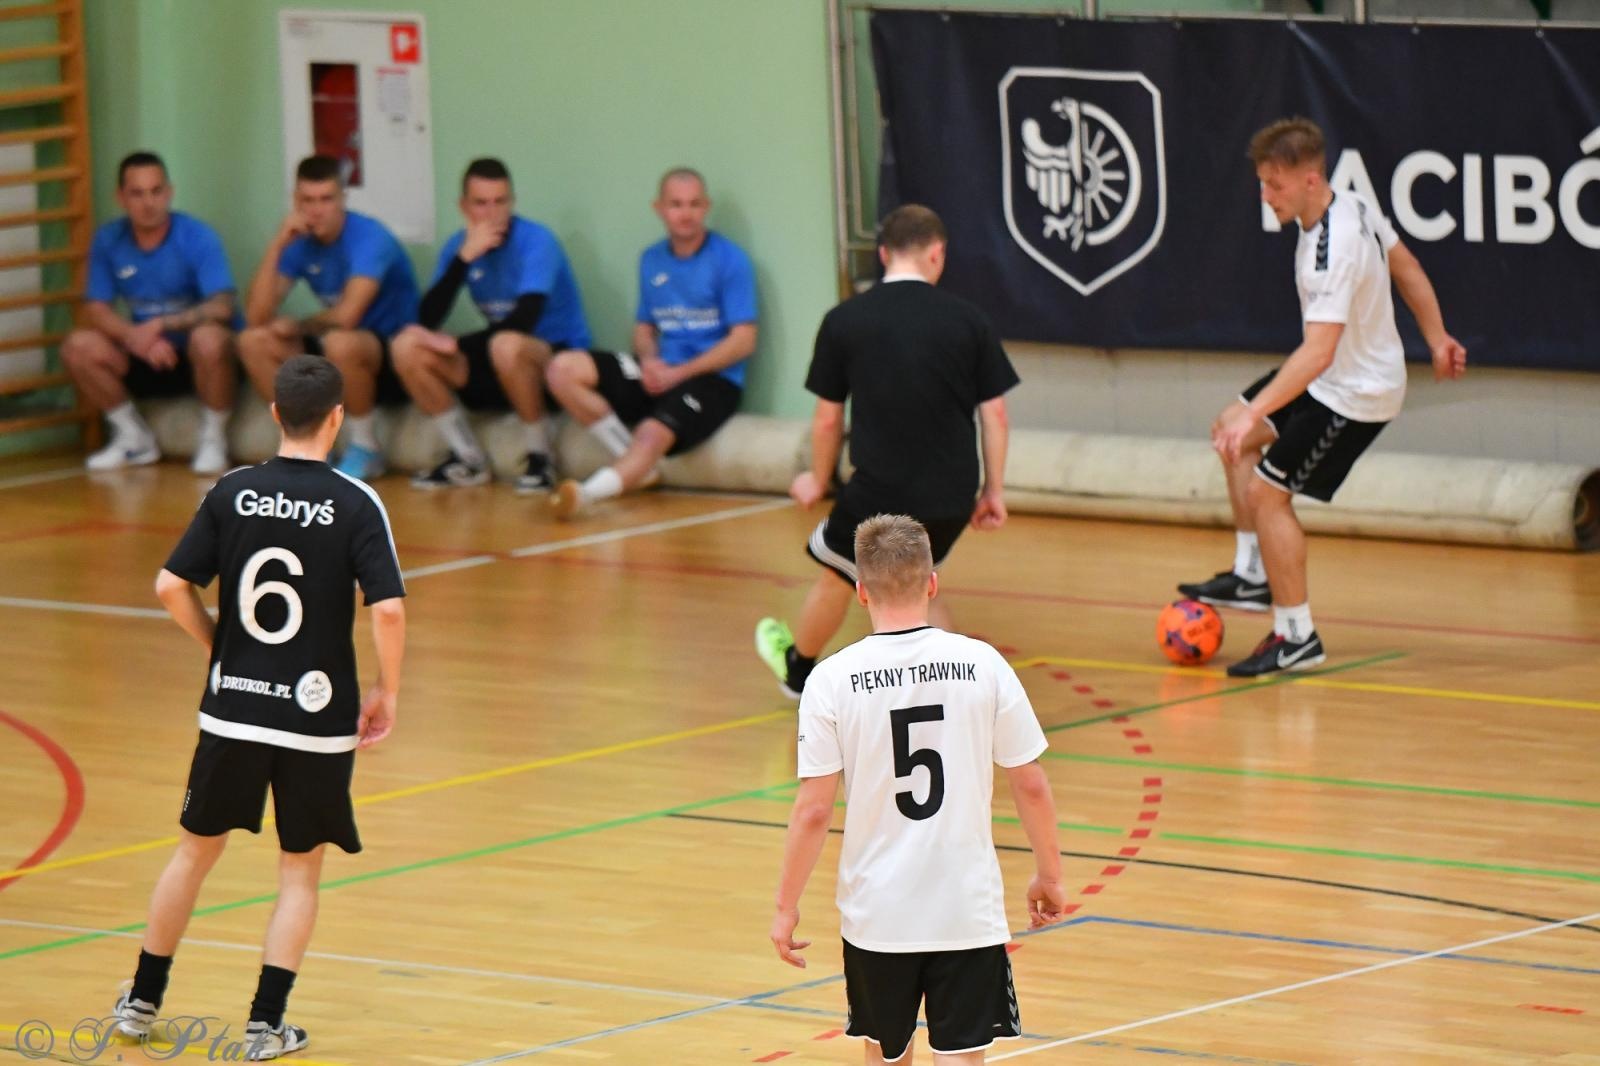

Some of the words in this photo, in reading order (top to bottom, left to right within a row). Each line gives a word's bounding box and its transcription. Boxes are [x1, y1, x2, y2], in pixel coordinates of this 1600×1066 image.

[1261, 125, 1600, 249] ACIBÓ
[234, 488, 335, 528] Gabryś
[238, 546, 304, 645] 6
[221, 675, 292, 699] DRUKOL.PL
[850, 667, 903, 694] PIĘKNY
[908, 661, 976, 684] TRAWNIK
[890, 703, 945, 821] 5
